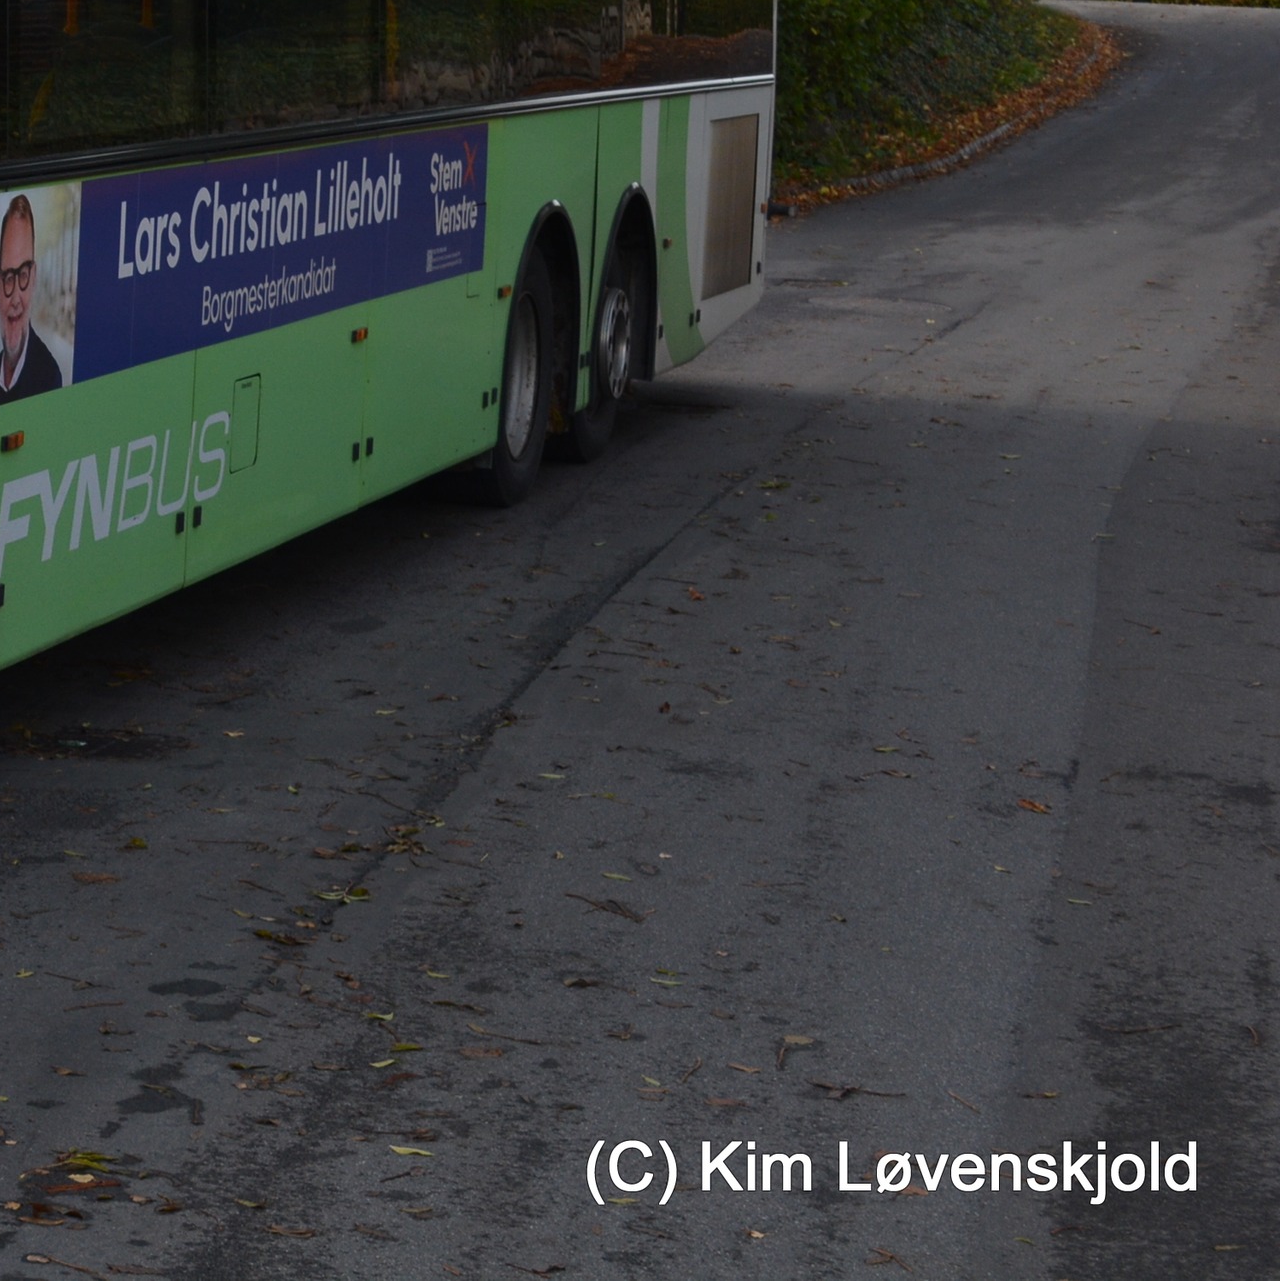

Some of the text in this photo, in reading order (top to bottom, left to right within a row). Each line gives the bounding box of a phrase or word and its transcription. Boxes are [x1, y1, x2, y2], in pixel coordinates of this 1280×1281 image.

[430, 152, 462, 194] Stem
[117, 153, 401, 279] Lars Christian Lilleholt
[434, 195, 477, 236] Venstre
[200, 256, 336, 333] Borgmesterkandidat
